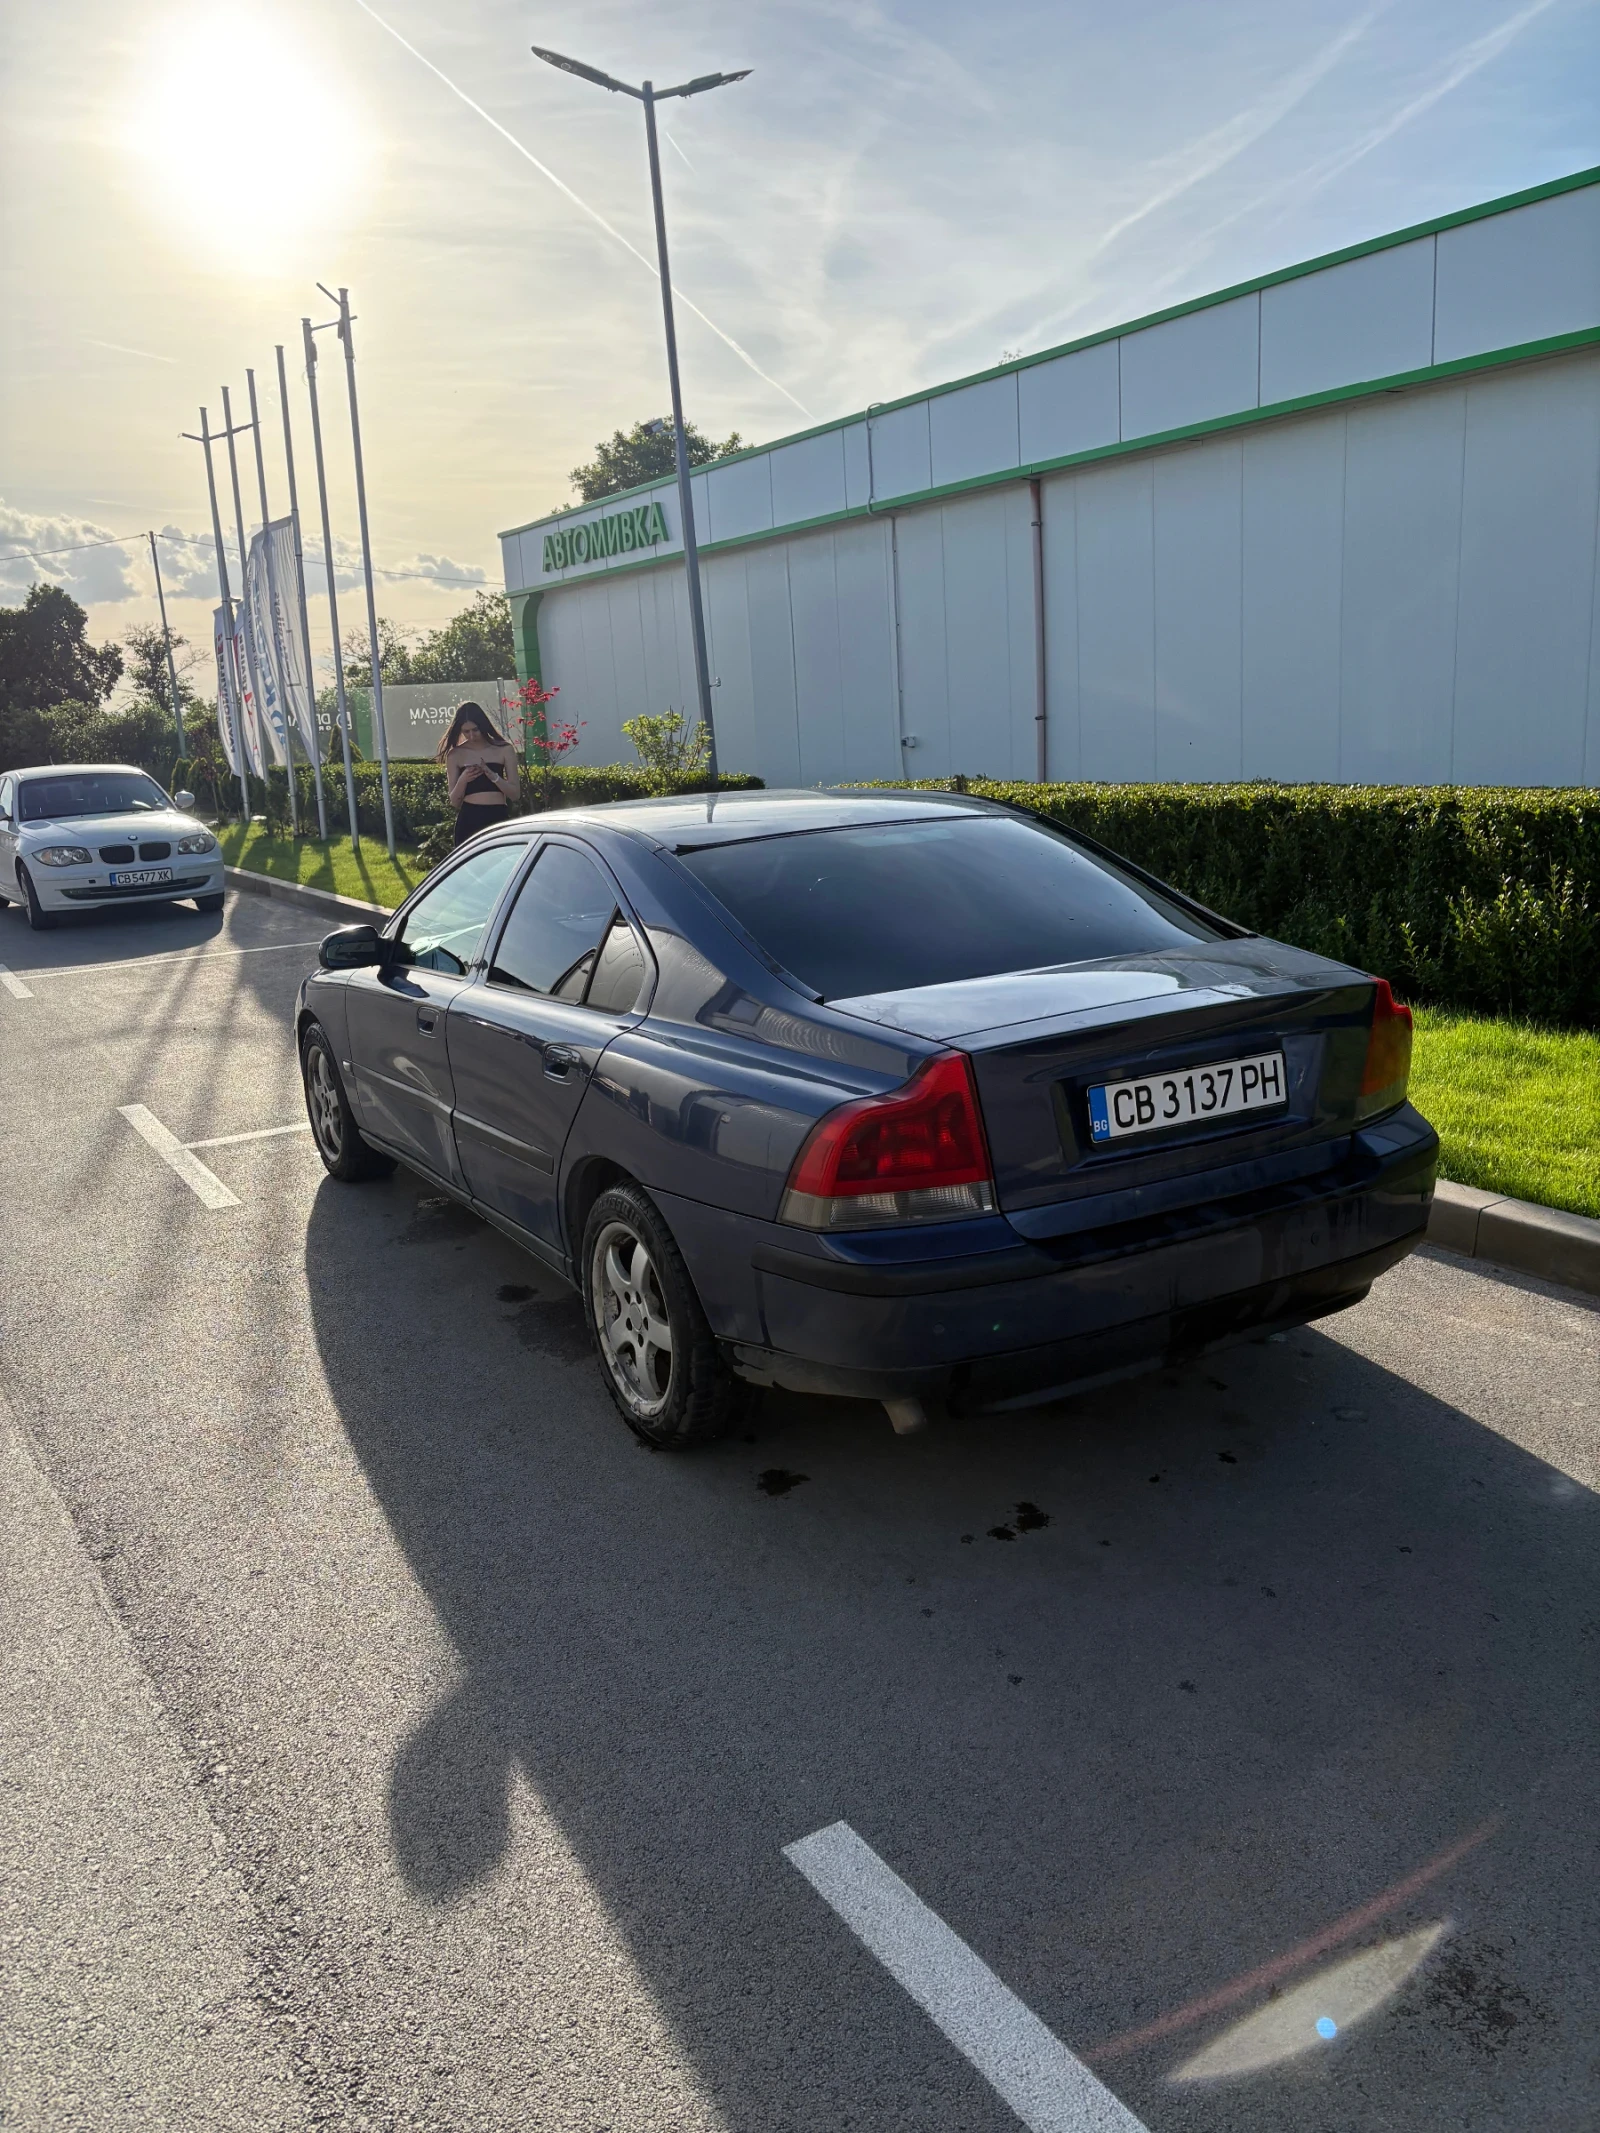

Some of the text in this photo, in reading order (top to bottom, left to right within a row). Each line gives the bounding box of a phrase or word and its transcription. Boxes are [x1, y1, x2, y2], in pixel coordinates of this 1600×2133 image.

[542, 501, 669, 572] АВТОМИВКА
[117, 870, 170, 884] CB 5477 XK
[1113, 1059, 1281, 1129] CB 3137 PH
[1093, 1119, 1108, 1133] BG
